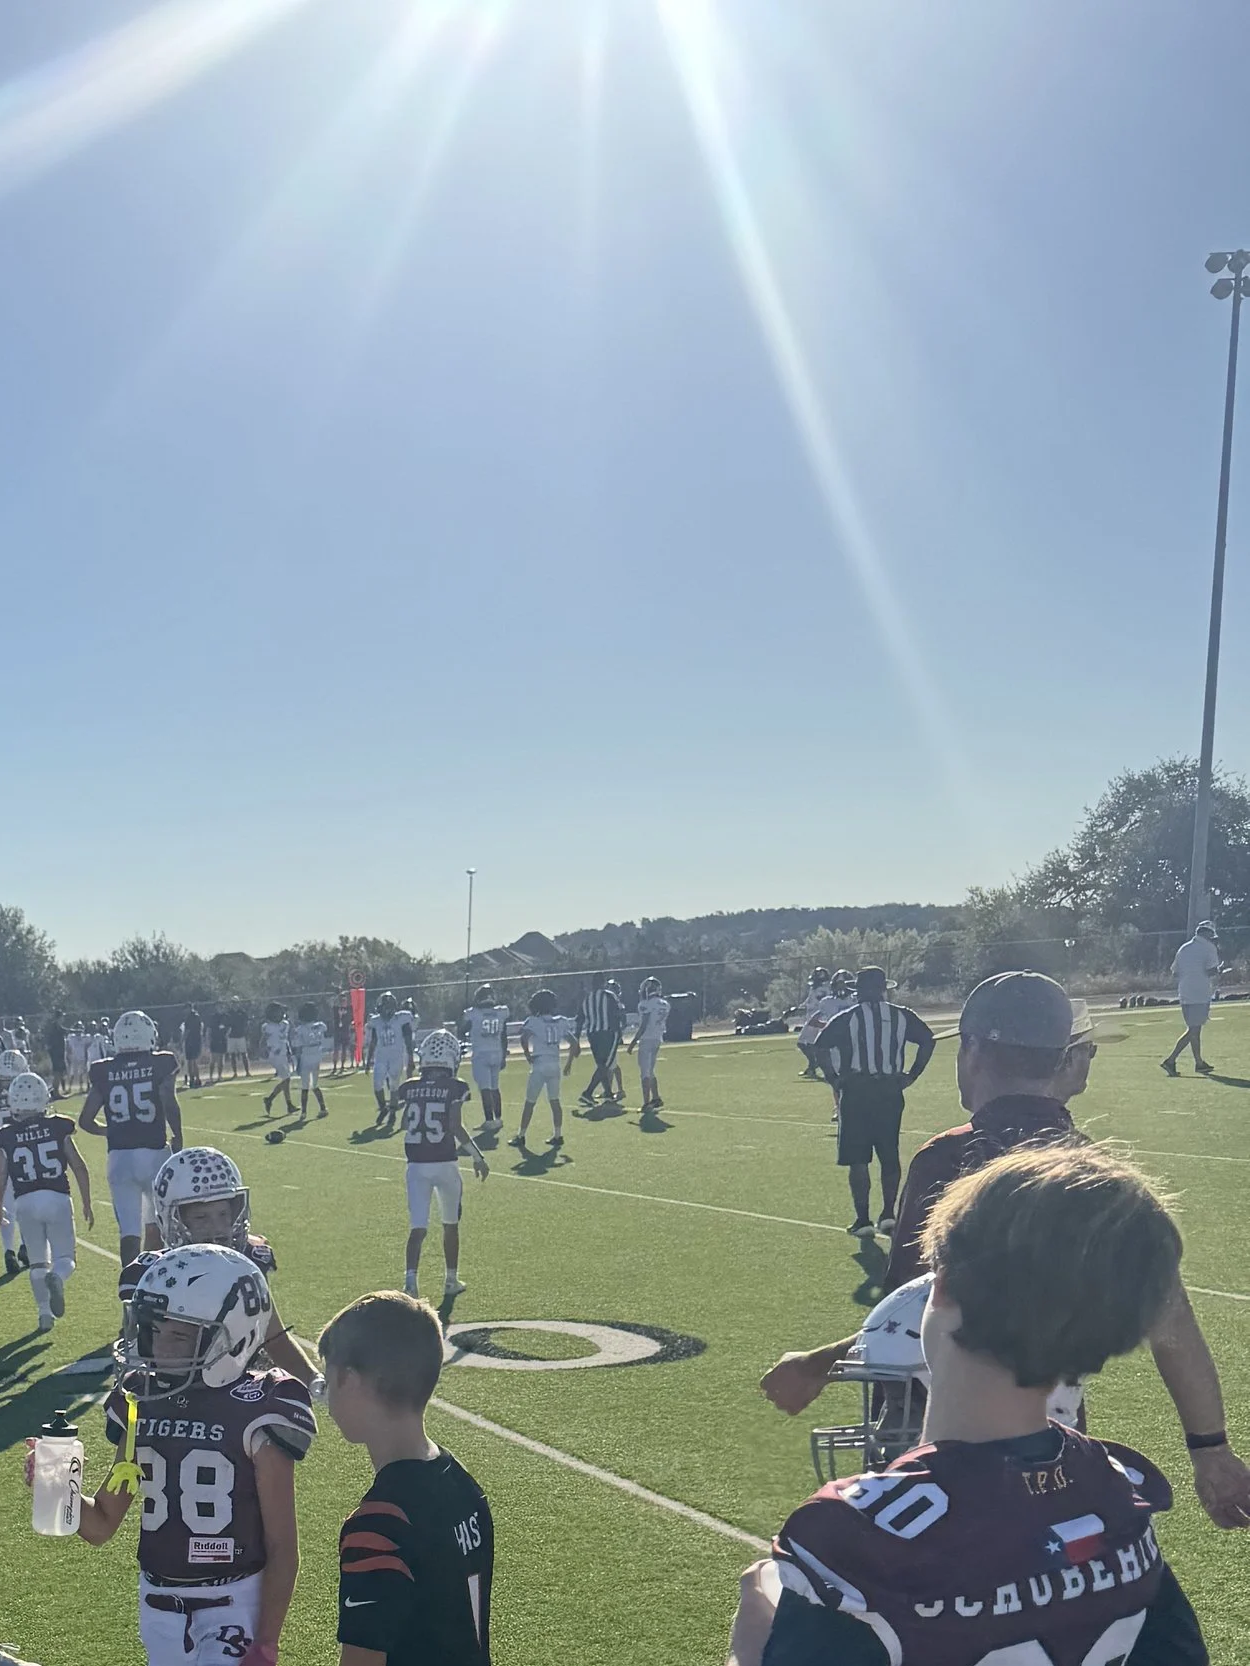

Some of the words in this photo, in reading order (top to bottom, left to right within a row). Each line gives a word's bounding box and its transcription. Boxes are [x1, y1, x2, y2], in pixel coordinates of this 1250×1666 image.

[108, 1067, 153, 1081] RAMIREZ
[109, 1081, 156, 1123] 95
[405, 1103, 446, 1144] 25
[13, 1141, 62, 1183] 35
[136, 1419, 225, 1441] TIGERS
